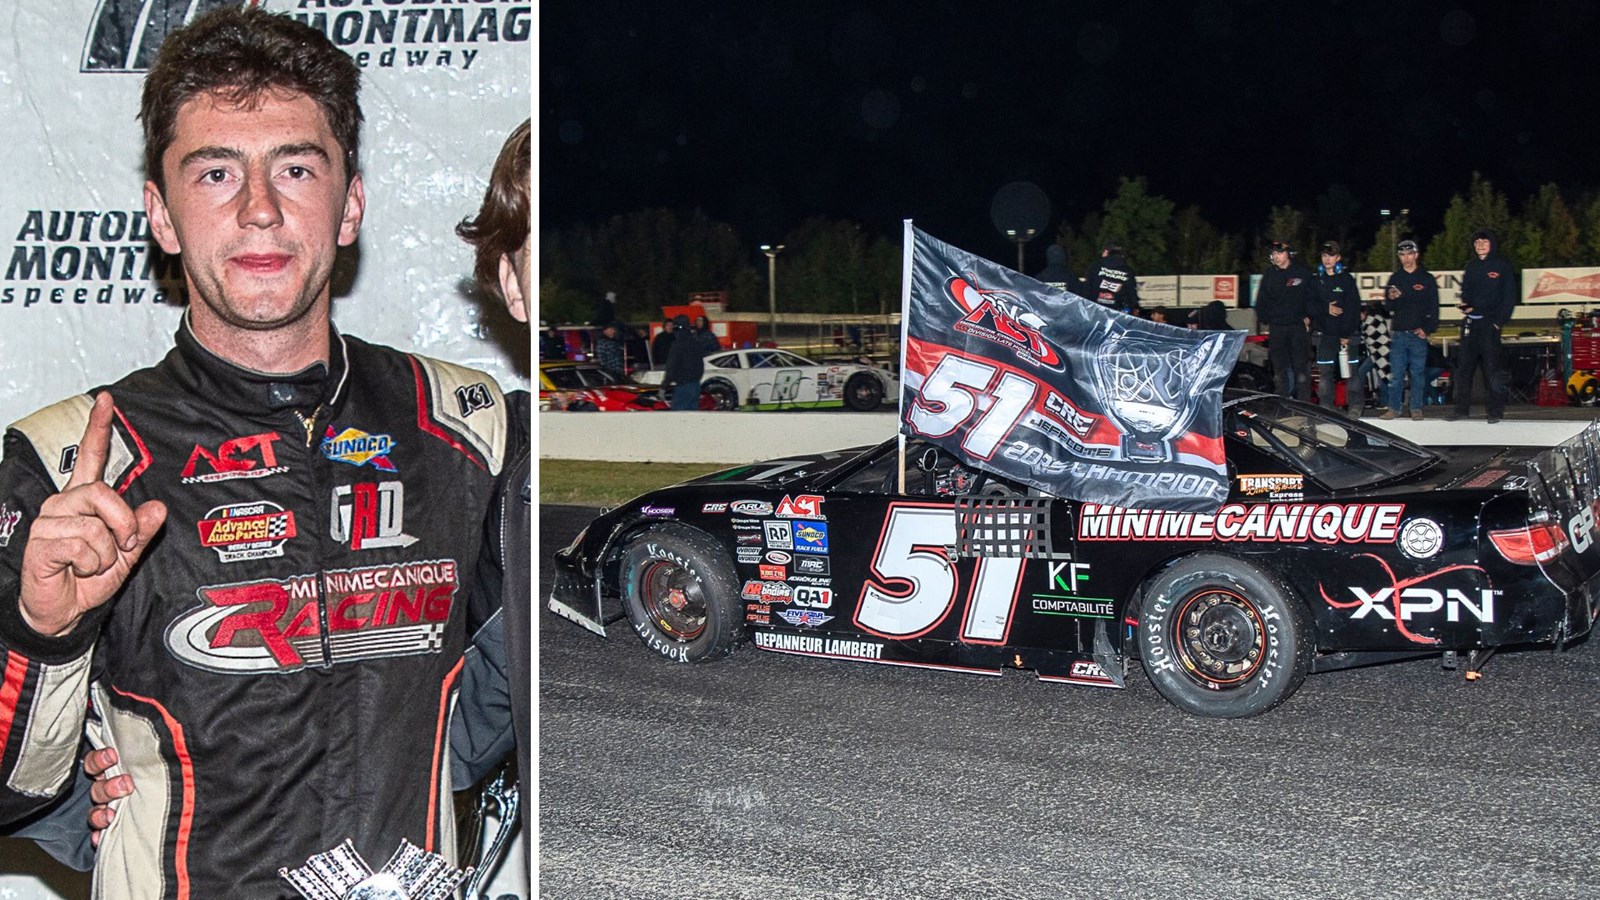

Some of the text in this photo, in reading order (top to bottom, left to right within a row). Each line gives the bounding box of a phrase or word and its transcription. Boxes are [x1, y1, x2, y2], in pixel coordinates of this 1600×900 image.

[356, 48, 478, 70] edway
[16, 210, 152, 242] AUTOD
[5, 246, 184, 281] MONTM
[967, 328, 997, 341] DIVISION
[997, 336, 1012, 347] LATE
[455, 383, 495, 418] K1
[906, 353, 1040, 461] 51
[1045, 391, 1095, 433] CRE
[180, 431, 281, 477] ACT
[1240, 477, 1304, 491] TRANSPORT
[776, 494, 825, 516] ACT
[1269, 492, 1304, 500] Express
[232, 505, 265, 516] NASCAR
[213, 519, 266, 533] Advance
[769, 527, 788, 540] RP
[1078, 503, 1405, 544] MINIMECANIQUE
[207, 530, 265, 544] Auto Parts
[797, 531, 824, 539] SUNOCO
[247, 550, 278, 558] CHAMPION
[853, 501, 1035, 645] 51
[1048, 561, 1090, 592] KF
[797, 589, 830, 605] QA1
[1032, 599, 1114, 615] COMPTABILITÉ
[1347, 586, 1494, 623] XPN
[754, 631, 884, 659] DEPANNEUR LAMBERT
